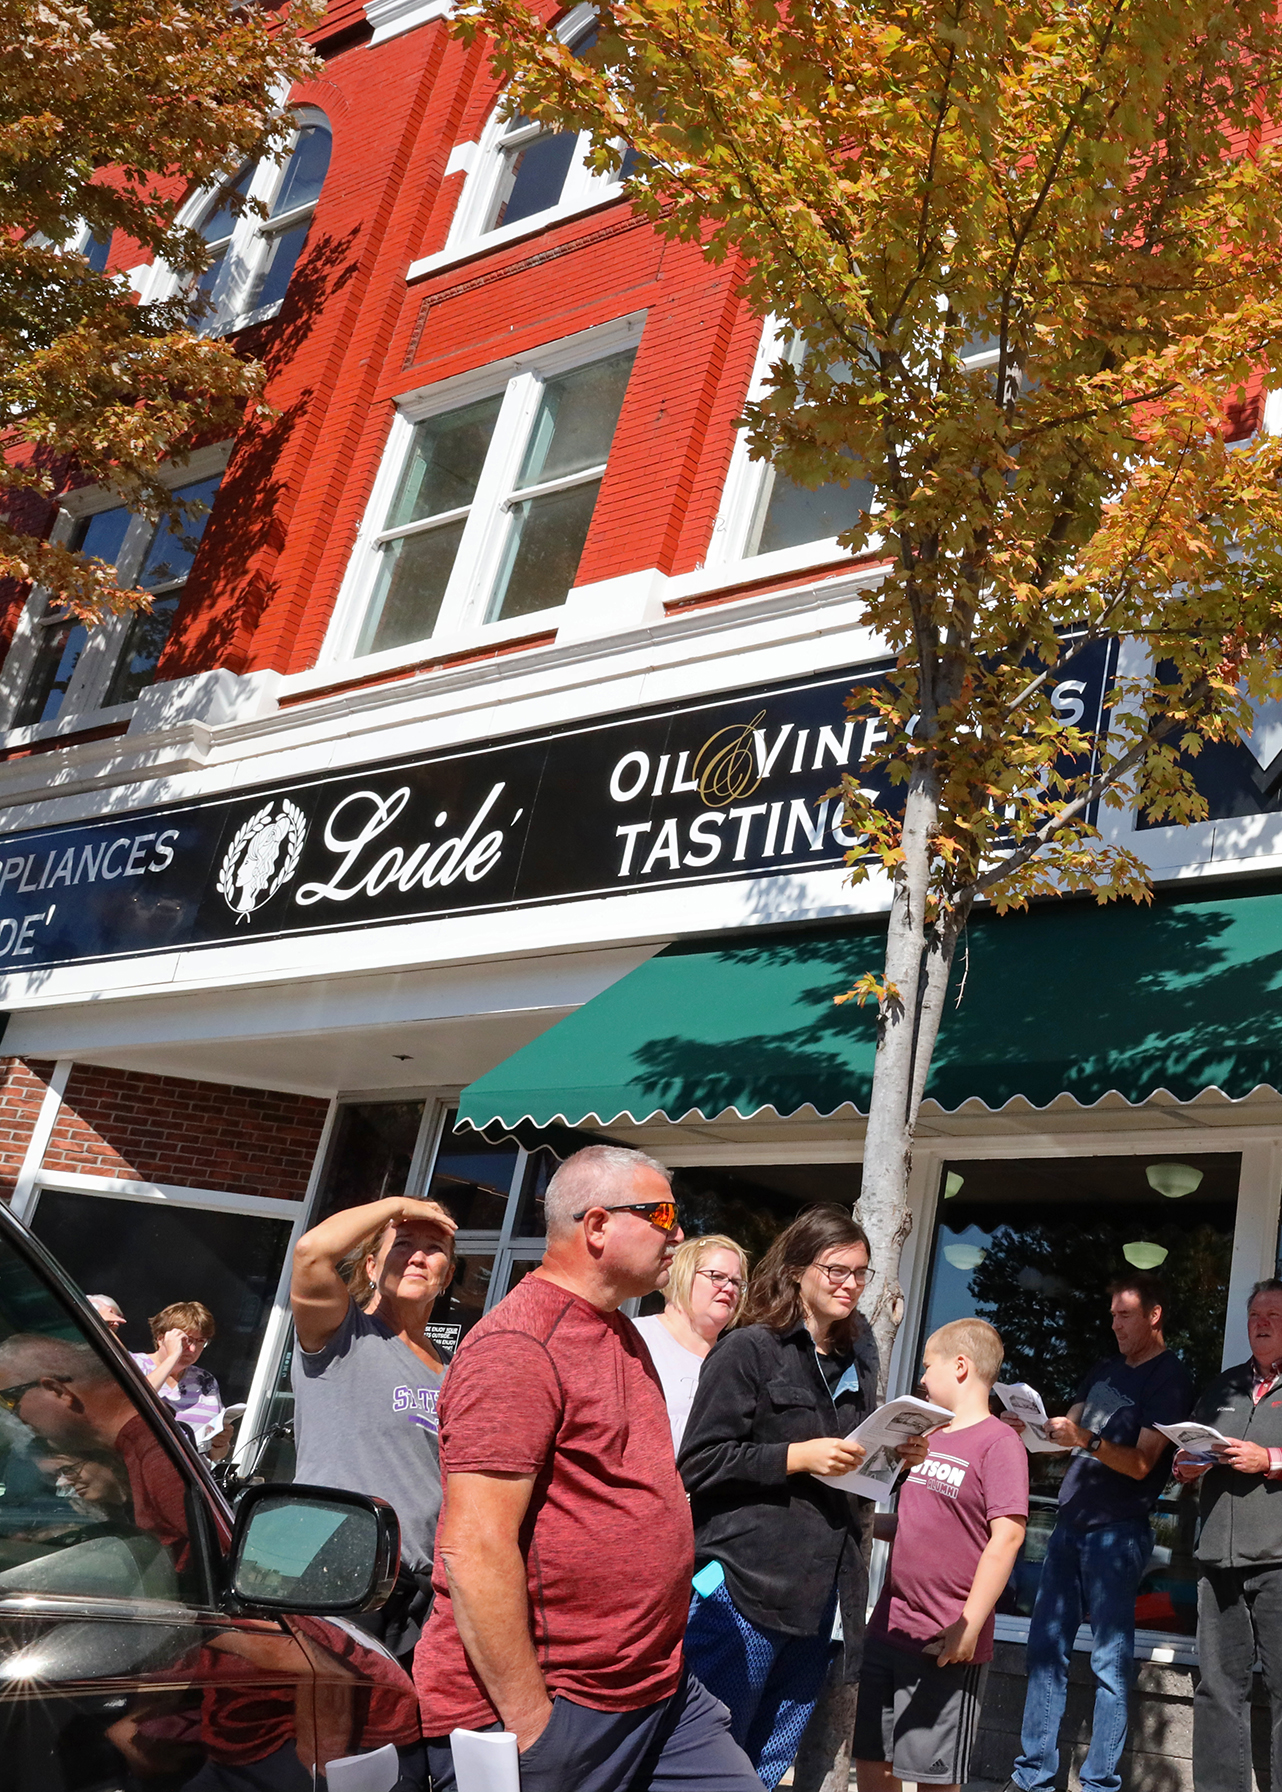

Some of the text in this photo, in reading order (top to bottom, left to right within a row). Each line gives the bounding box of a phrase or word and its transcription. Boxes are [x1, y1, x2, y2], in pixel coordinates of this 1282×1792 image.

[609, 750, 700, 802] OIL
[0, 829, 181, 897] PLIANCES
[926, 1478, 960, 1500] ALUMNI
